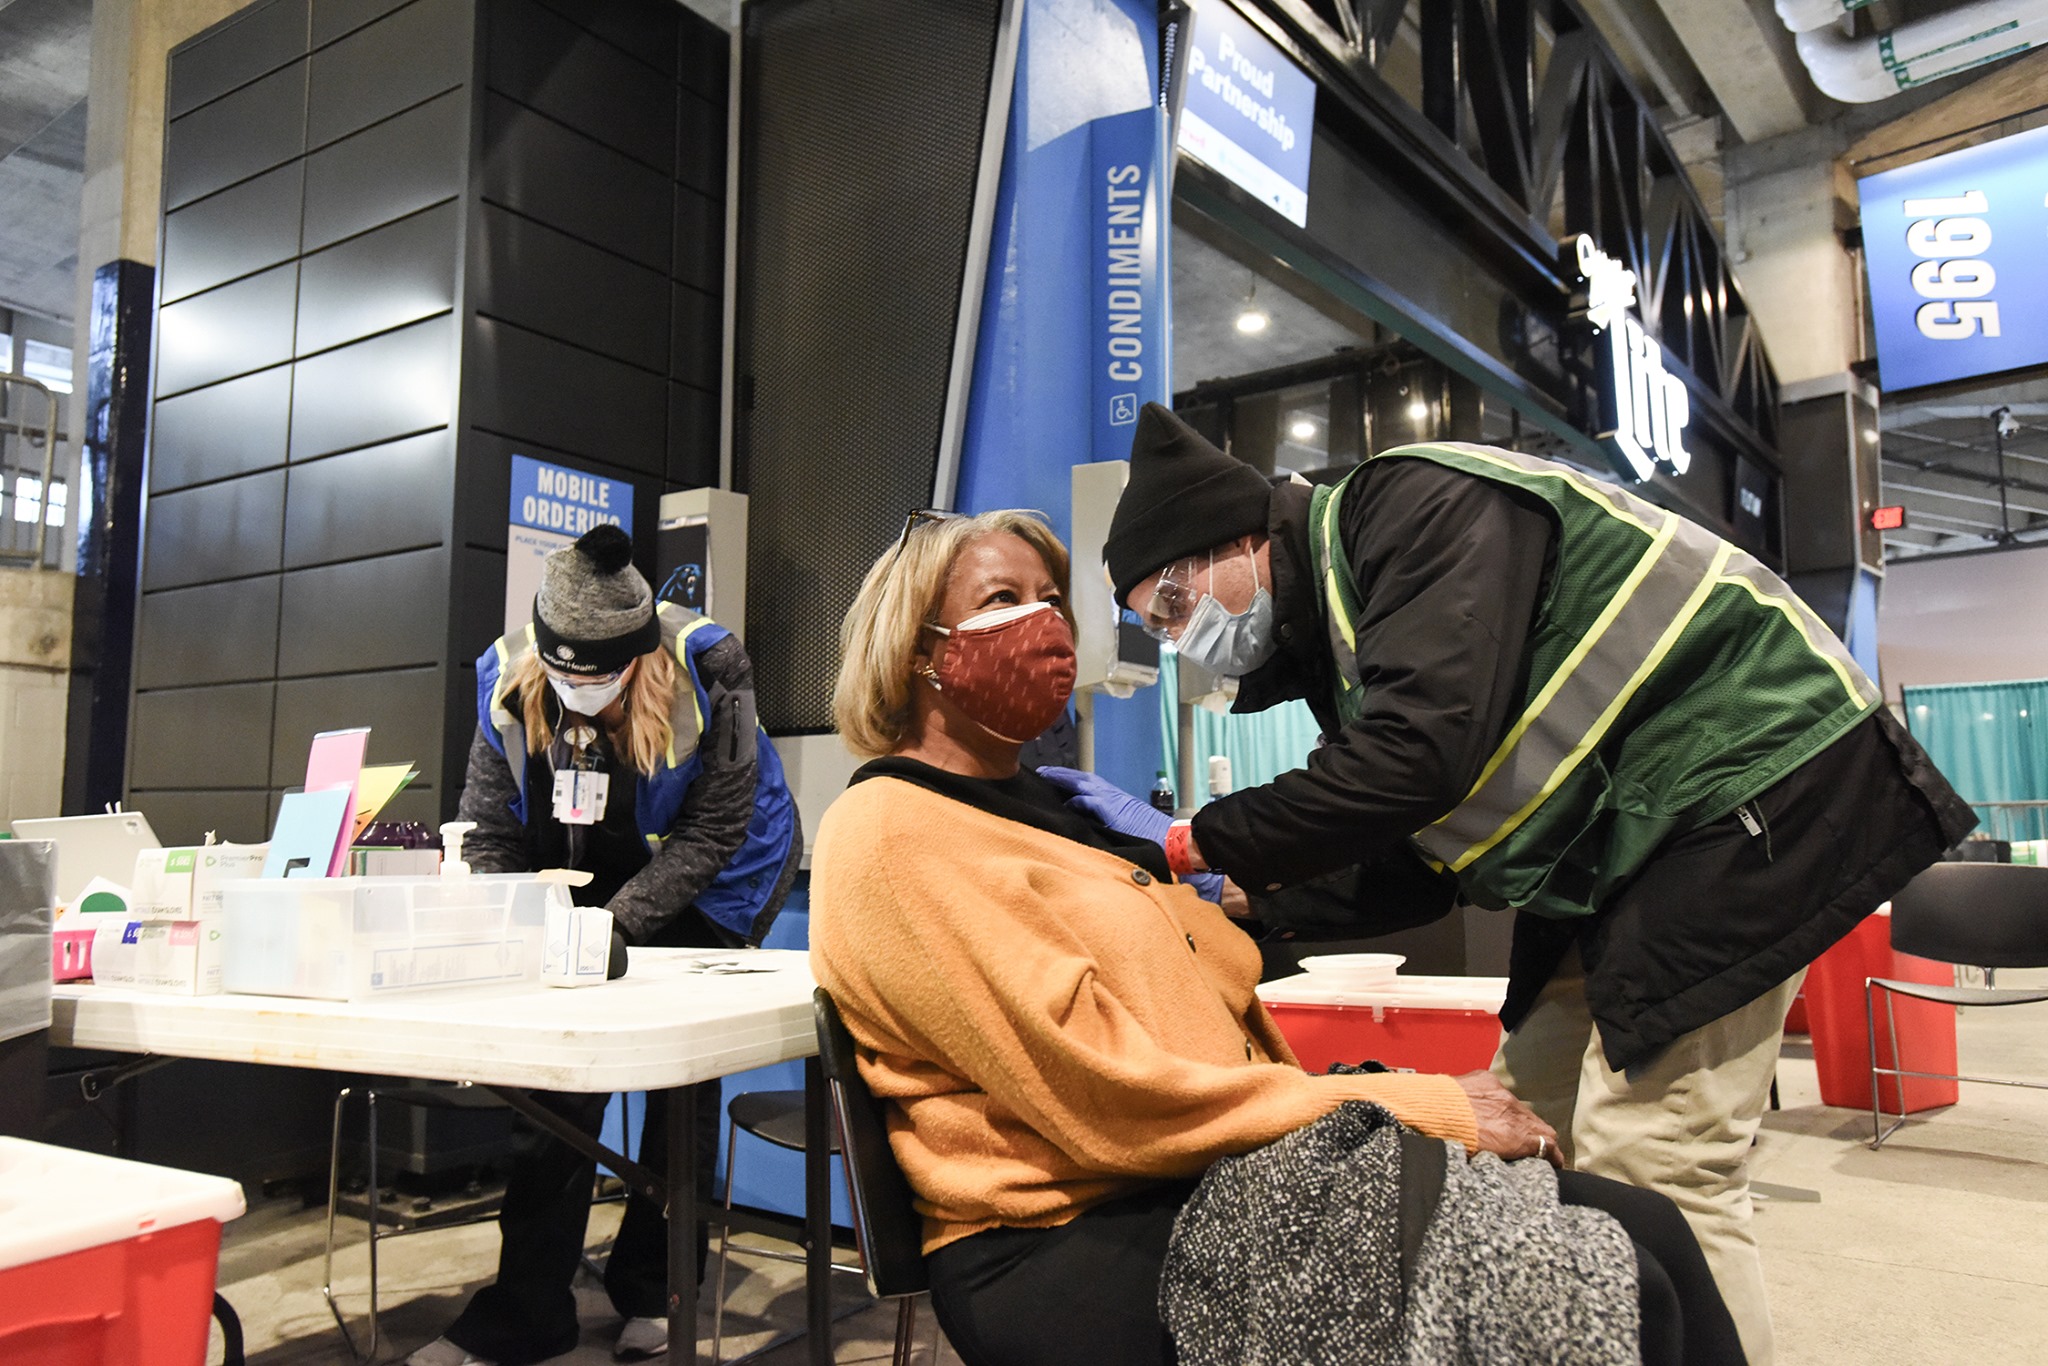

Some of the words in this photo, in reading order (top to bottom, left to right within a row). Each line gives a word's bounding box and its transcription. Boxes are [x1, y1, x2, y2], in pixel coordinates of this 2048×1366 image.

[1187, 45, 1295, 151] Partnership
[1218, 31, 1275, 99] Proud
[1107, 164, 1142, 382] CONDIMENTS
[1903, 190, 2001, 340] 1995
[538, 466, 610, 509] MOBILE
